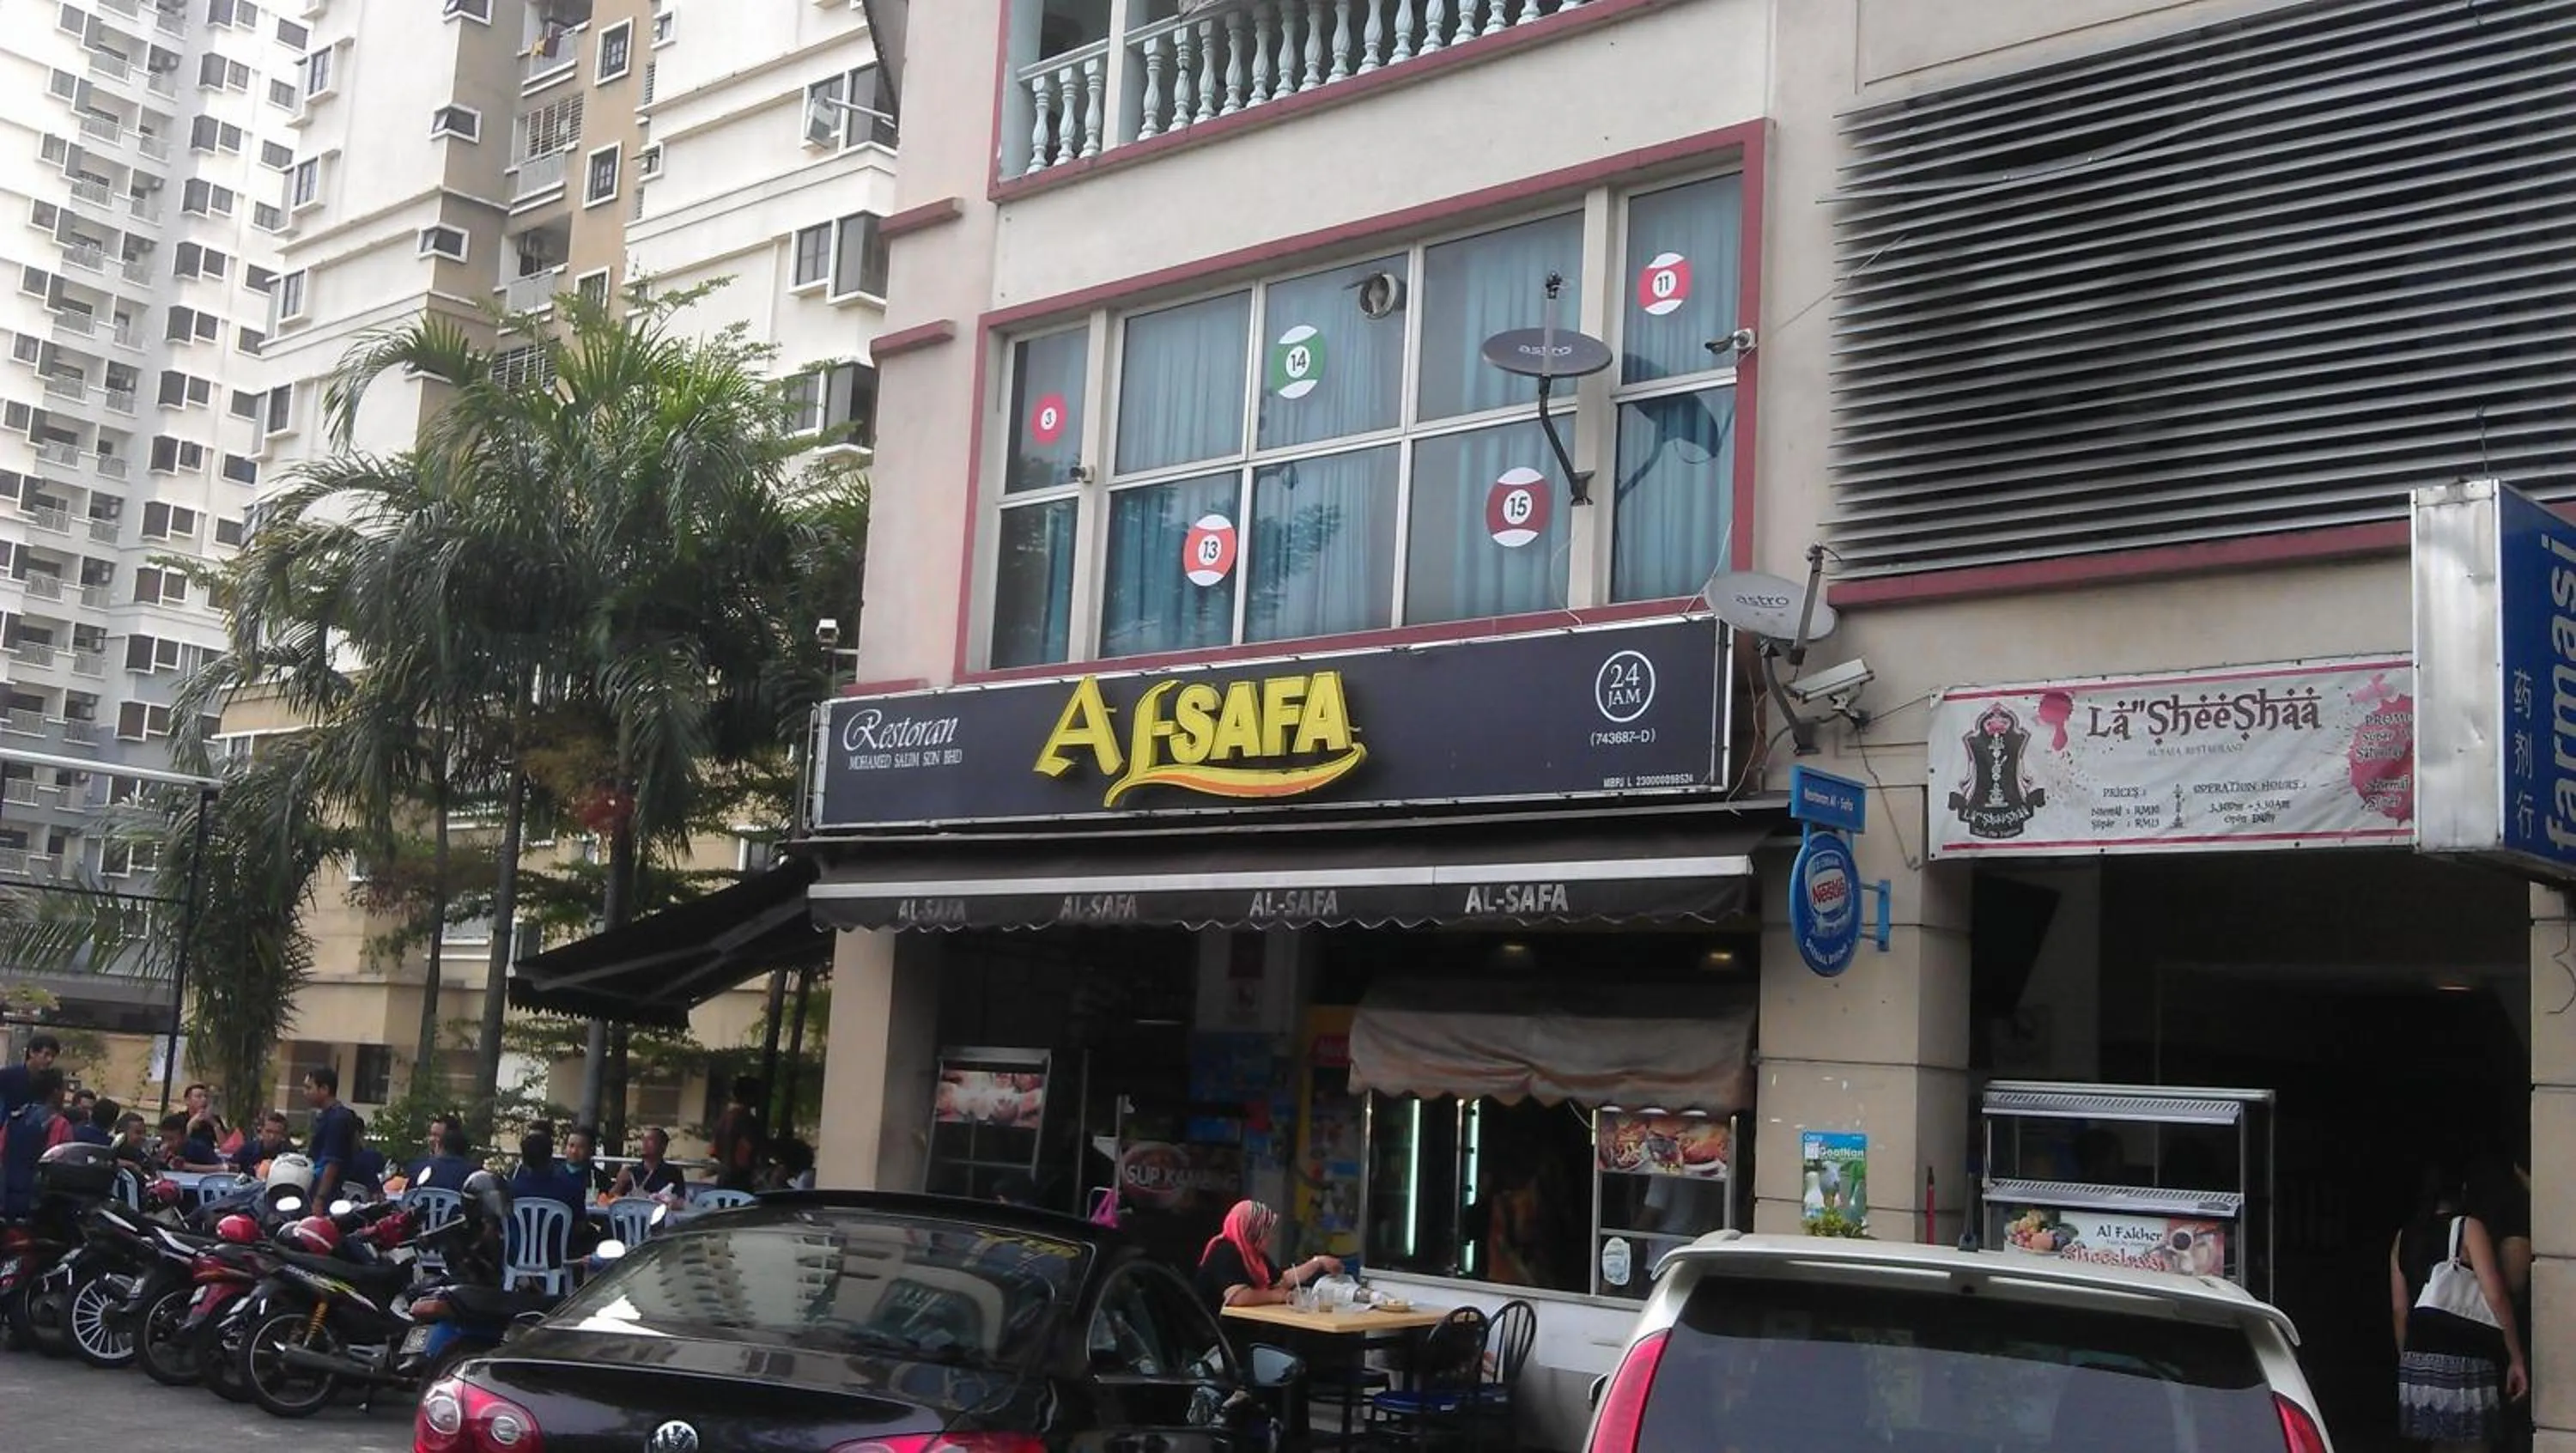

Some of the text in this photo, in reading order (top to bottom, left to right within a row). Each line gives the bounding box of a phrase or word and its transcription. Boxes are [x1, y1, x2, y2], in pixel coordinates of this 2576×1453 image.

[1656, 275, 1671, 292] 11
[1518, 344, 1572, 356] asro
[1290, 350, 1307, 372] 14
[1044, 411, 1053, 426] 3
[1508, 495, 1528, 518] 15
[1201, 539, 1218, 560] 13
[1735, 593, 1789, 608] astro
[1610, 662, 1640, 688] 24
[1607, 688, 1642, 708] JAM
[842, 708, 959, 751] Restoran
[848, 753, 892, 770] MOHAMED
[2102, 787, 2140, 799] PRICES
[2193, 781, 2257, 793] OPERATION
[897, 883, 1569, 921] AL-SAFA AL-SAFA AL-SAFA AL-SAFA
[1127, 1164, 1160, 1186] SUP
[2096, 1224, 2163, 1242] Al Fakher
